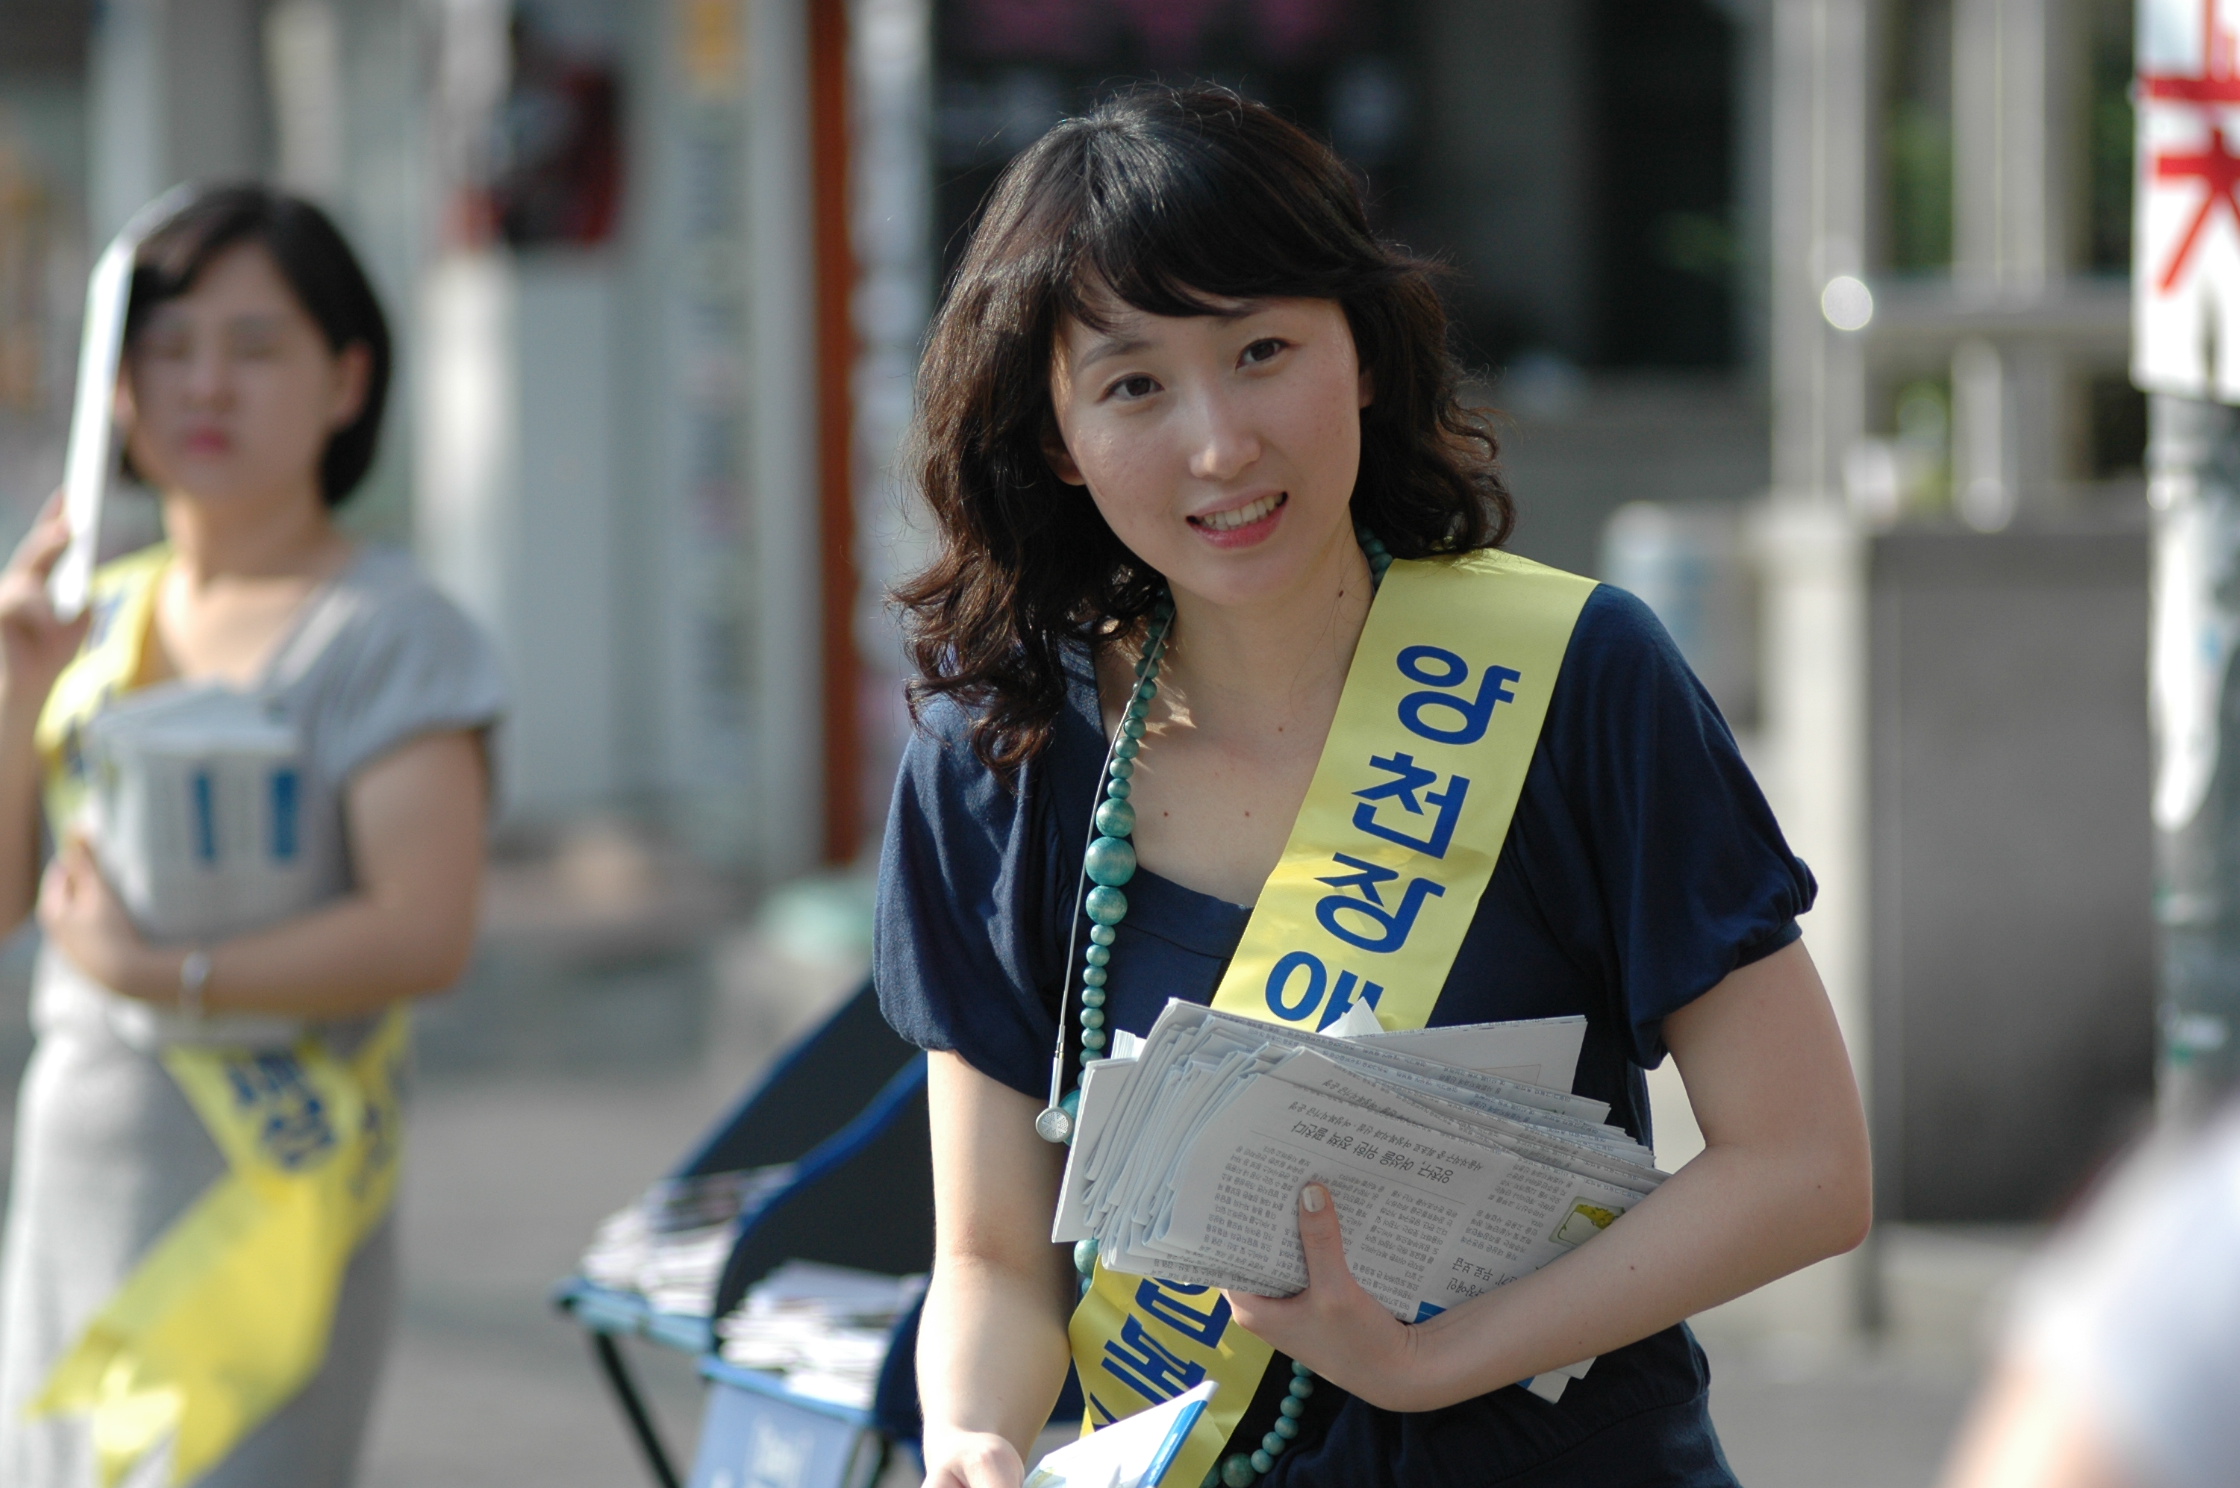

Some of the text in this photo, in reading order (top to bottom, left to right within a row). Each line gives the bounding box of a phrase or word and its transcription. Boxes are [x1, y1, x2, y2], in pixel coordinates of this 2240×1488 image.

[1288, 1101, 1306, 1112] 운영
[1306, 1107, 1351, 1126] 여성복지기금
[1356, 1123, 1373, 1134] 신설
[1374, 1130, 1411, 1148] 여성복지과
[1292, 1121, 1453, 1183] 양천구, 여성을 위한 정책 펼친다
[1413, 1143, 1436, 1156] 최초로
[1446, 1154, 1481, 1170] 서울자치구
[1452, 1257, 1473, 1273] 보급
[1474, 1266, 1493, 1281] 무료
